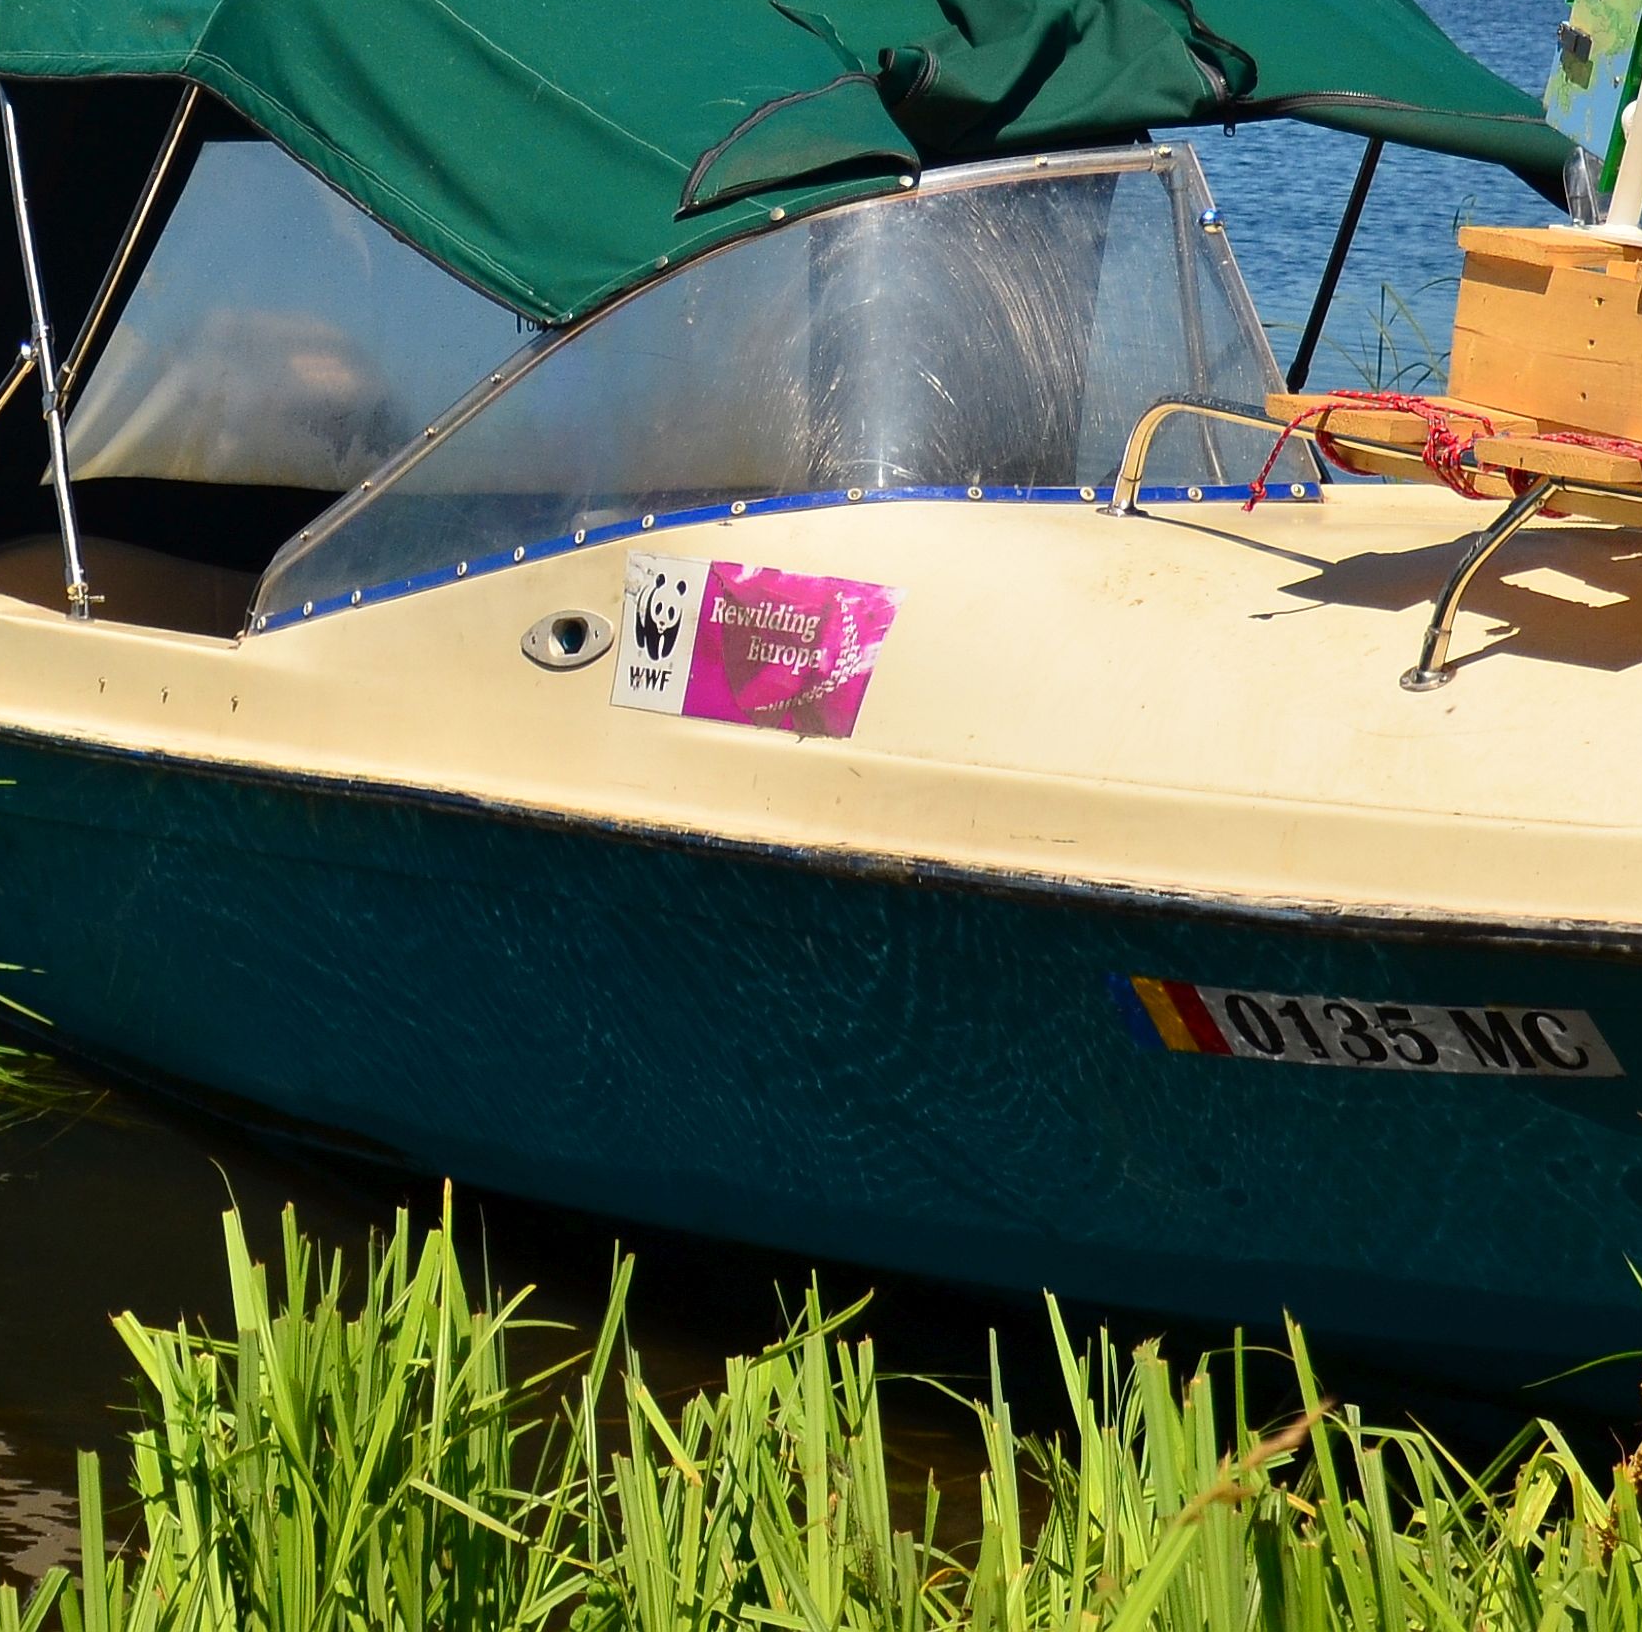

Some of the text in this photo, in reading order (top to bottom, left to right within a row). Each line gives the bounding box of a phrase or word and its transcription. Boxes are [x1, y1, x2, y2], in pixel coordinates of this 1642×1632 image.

[710, 596, 821, 642] Rewilding
[746, 635, 823, 676] Europe
[630, 666, 672, 692] WWF
[1226, 994, 1589, 1071] 0135 MC
